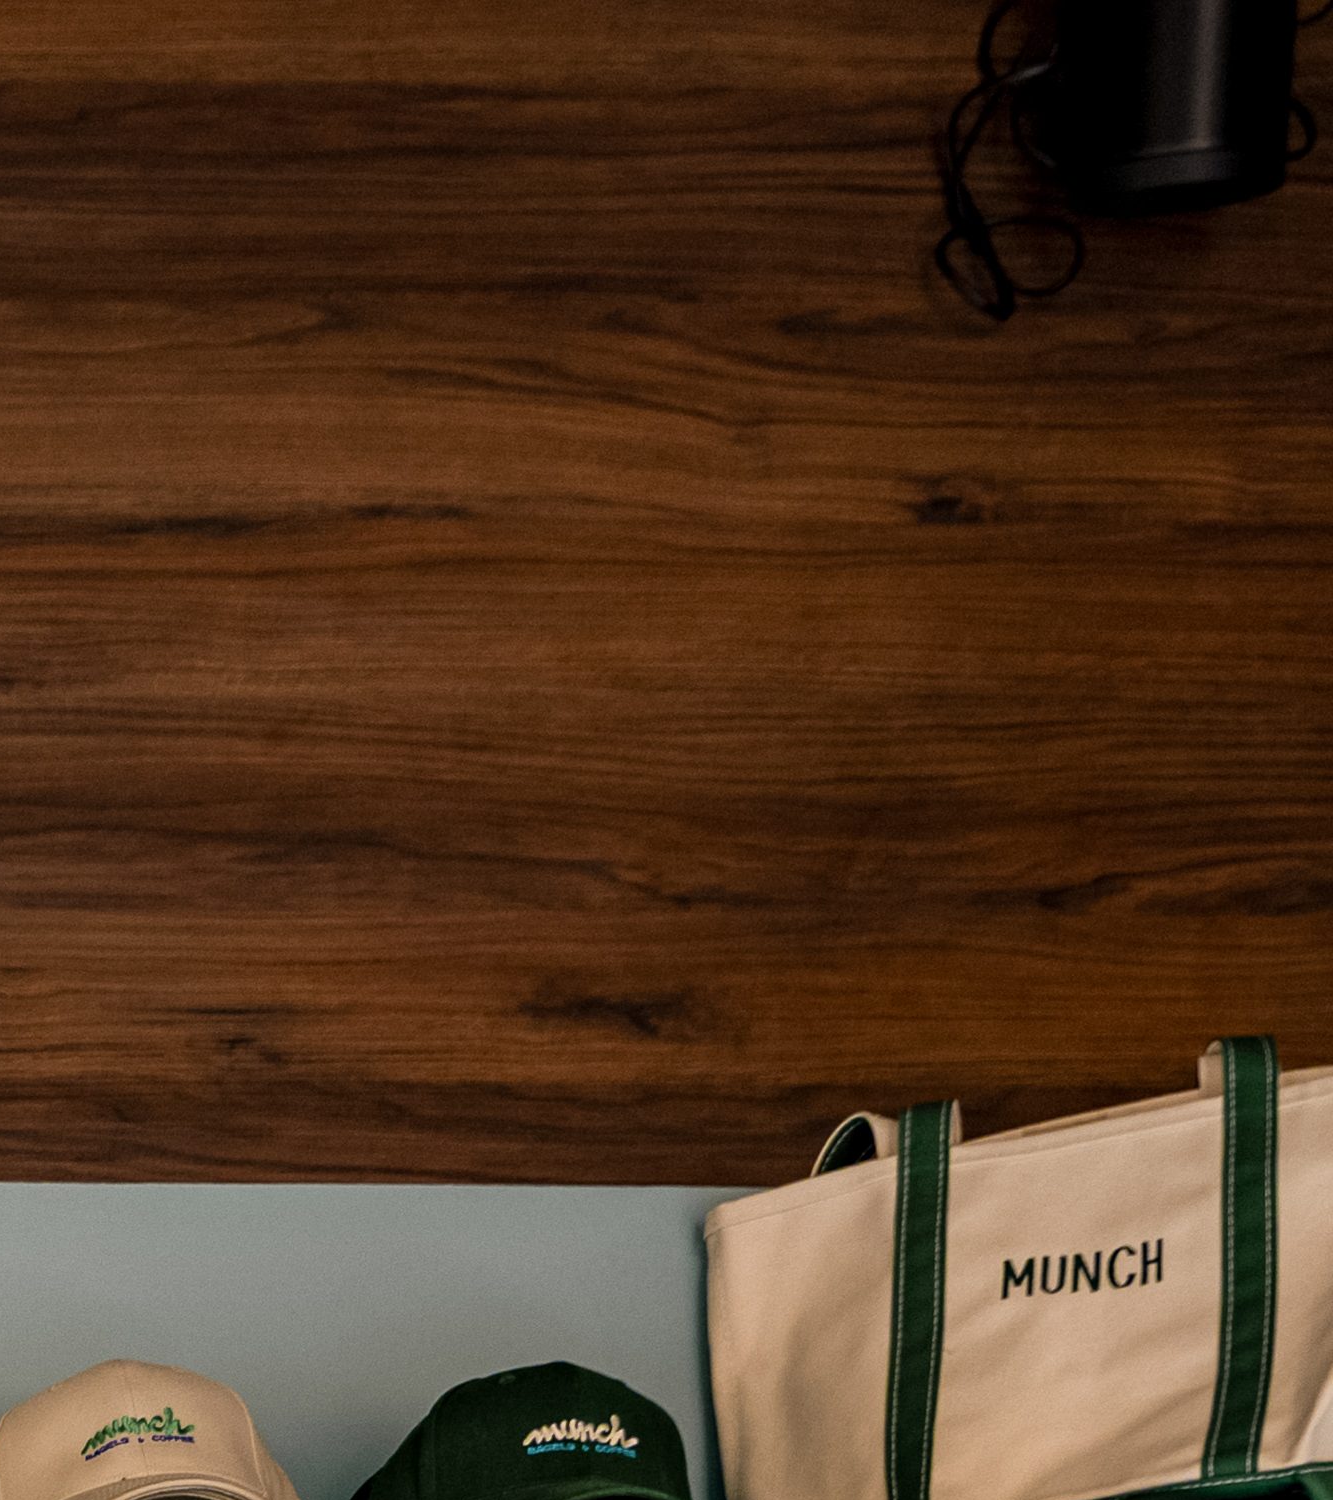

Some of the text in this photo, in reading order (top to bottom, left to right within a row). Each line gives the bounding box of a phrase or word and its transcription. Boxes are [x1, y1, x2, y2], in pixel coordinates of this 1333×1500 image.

[1001, 1238, 1163, 1300] MUNCH
[81, 1406, 195, 1455] munch
[522, 1414, 640, 1448] munch
